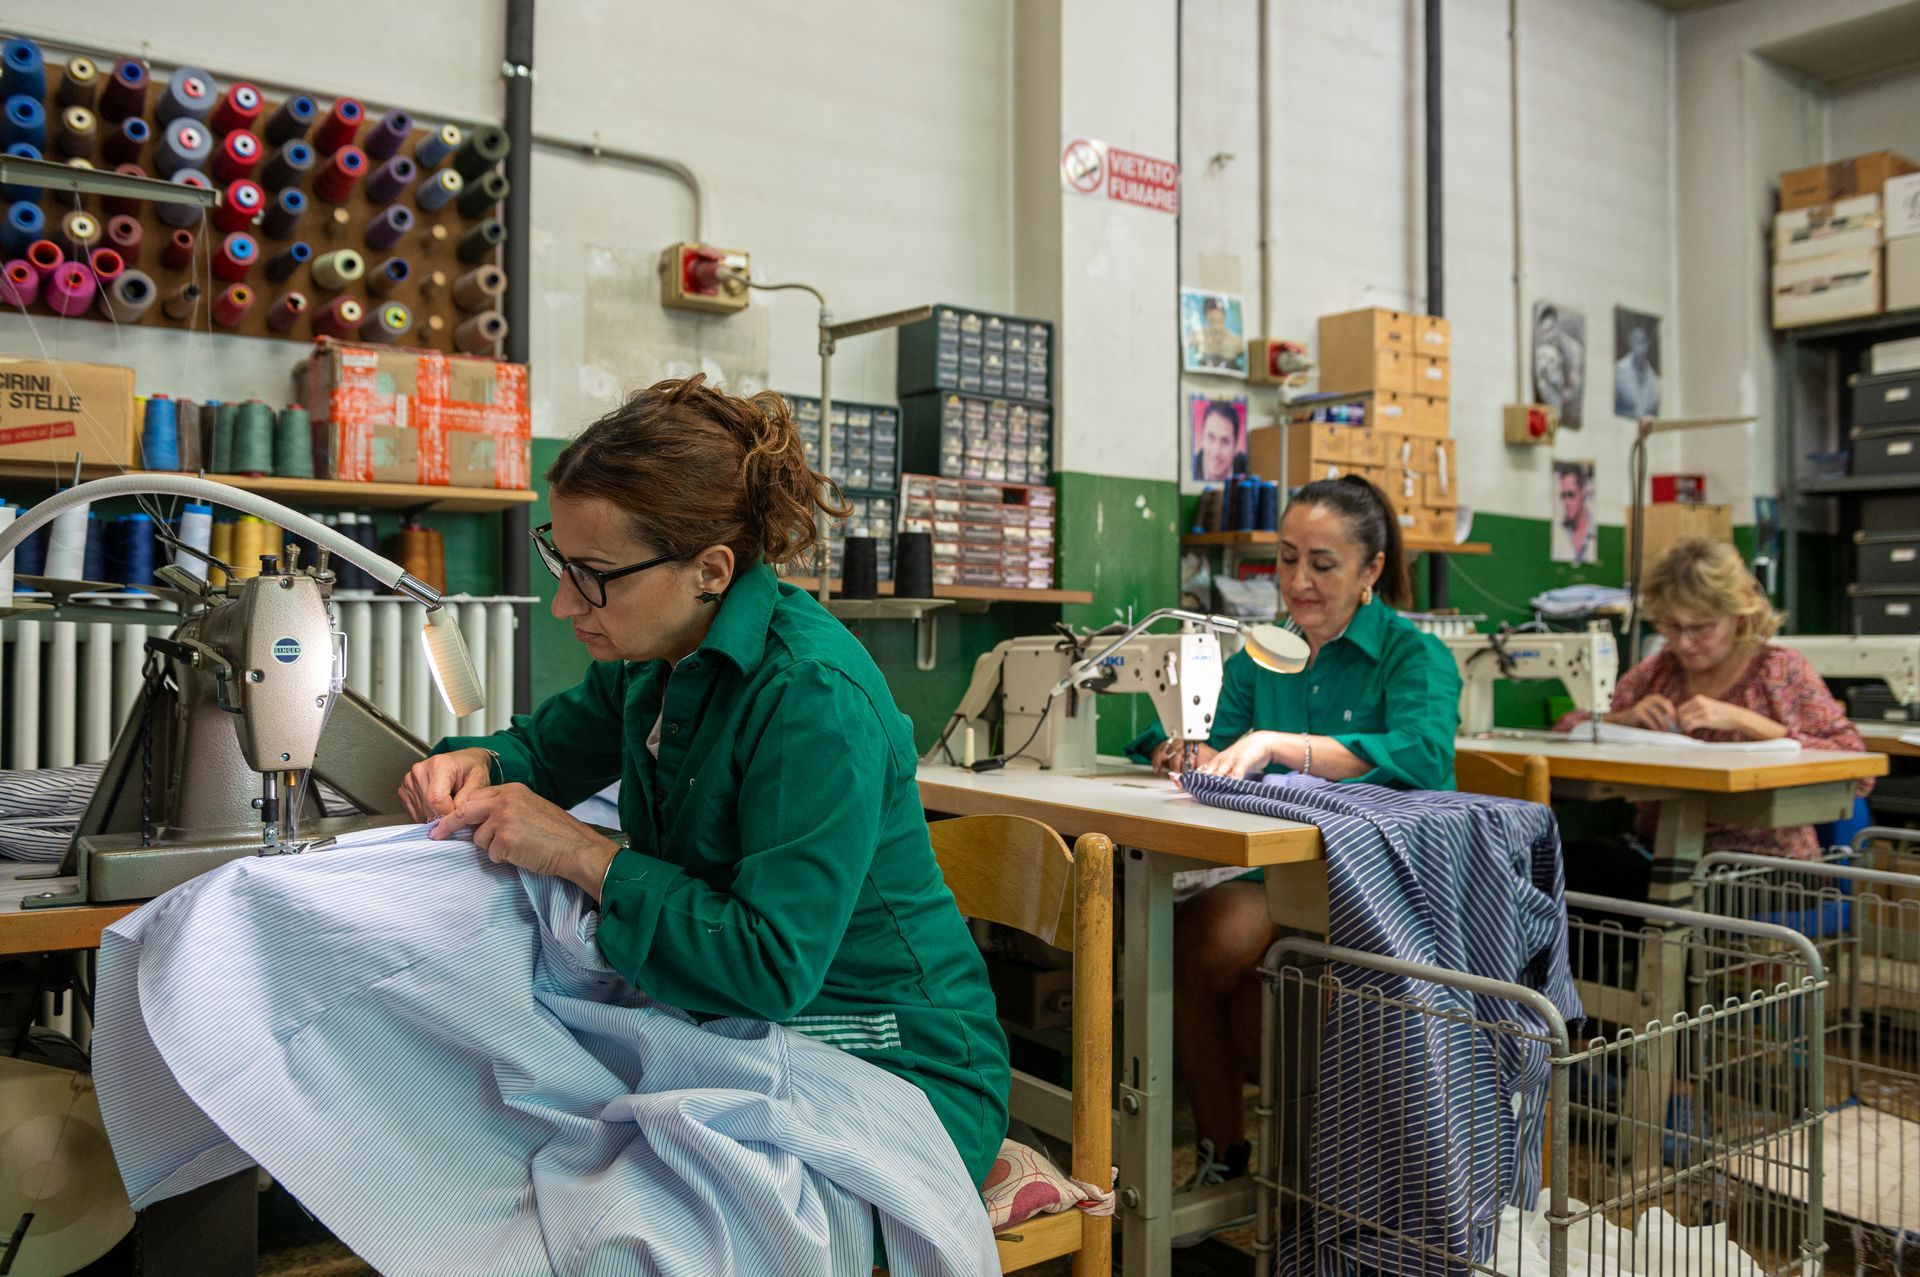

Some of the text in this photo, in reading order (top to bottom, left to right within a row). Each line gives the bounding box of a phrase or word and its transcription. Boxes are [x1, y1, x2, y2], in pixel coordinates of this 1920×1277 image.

[1109, 151, 1175, 187] VIETATO
[1110, 179, 1177, 212] FUMARE
[9, 391, 82, 413] STELLE
